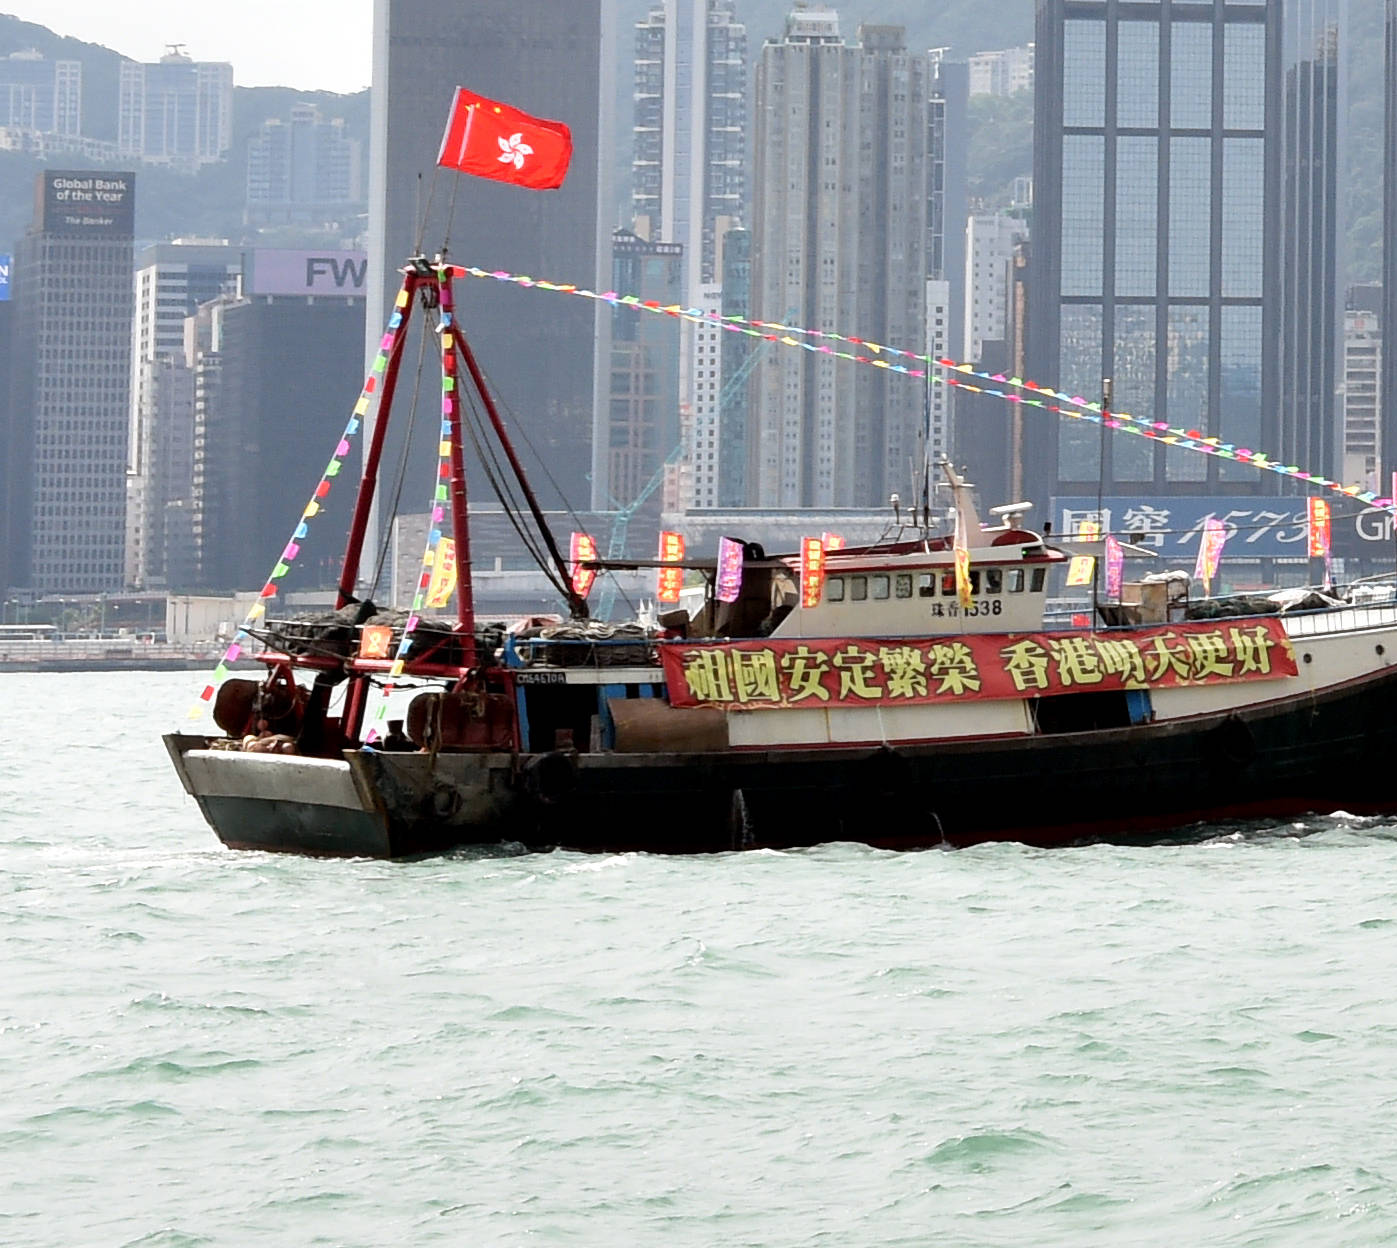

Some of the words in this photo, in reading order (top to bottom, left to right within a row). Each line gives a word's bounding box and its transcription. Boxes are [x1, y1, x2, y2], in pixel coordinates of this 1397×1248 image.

[53, 178, 92, 190] Global
[95, 179, 126, 190] Bank
[56, 190, 70, 201] of
[72, 191, 92, 201] the
[95, 191, 123, 202] Year
[1177, 510, 1310, 545] 1573
[684, 641, 982, 703] 祖國安定繁榮
[1000, 625, 1276, 692] 香港明天更好
